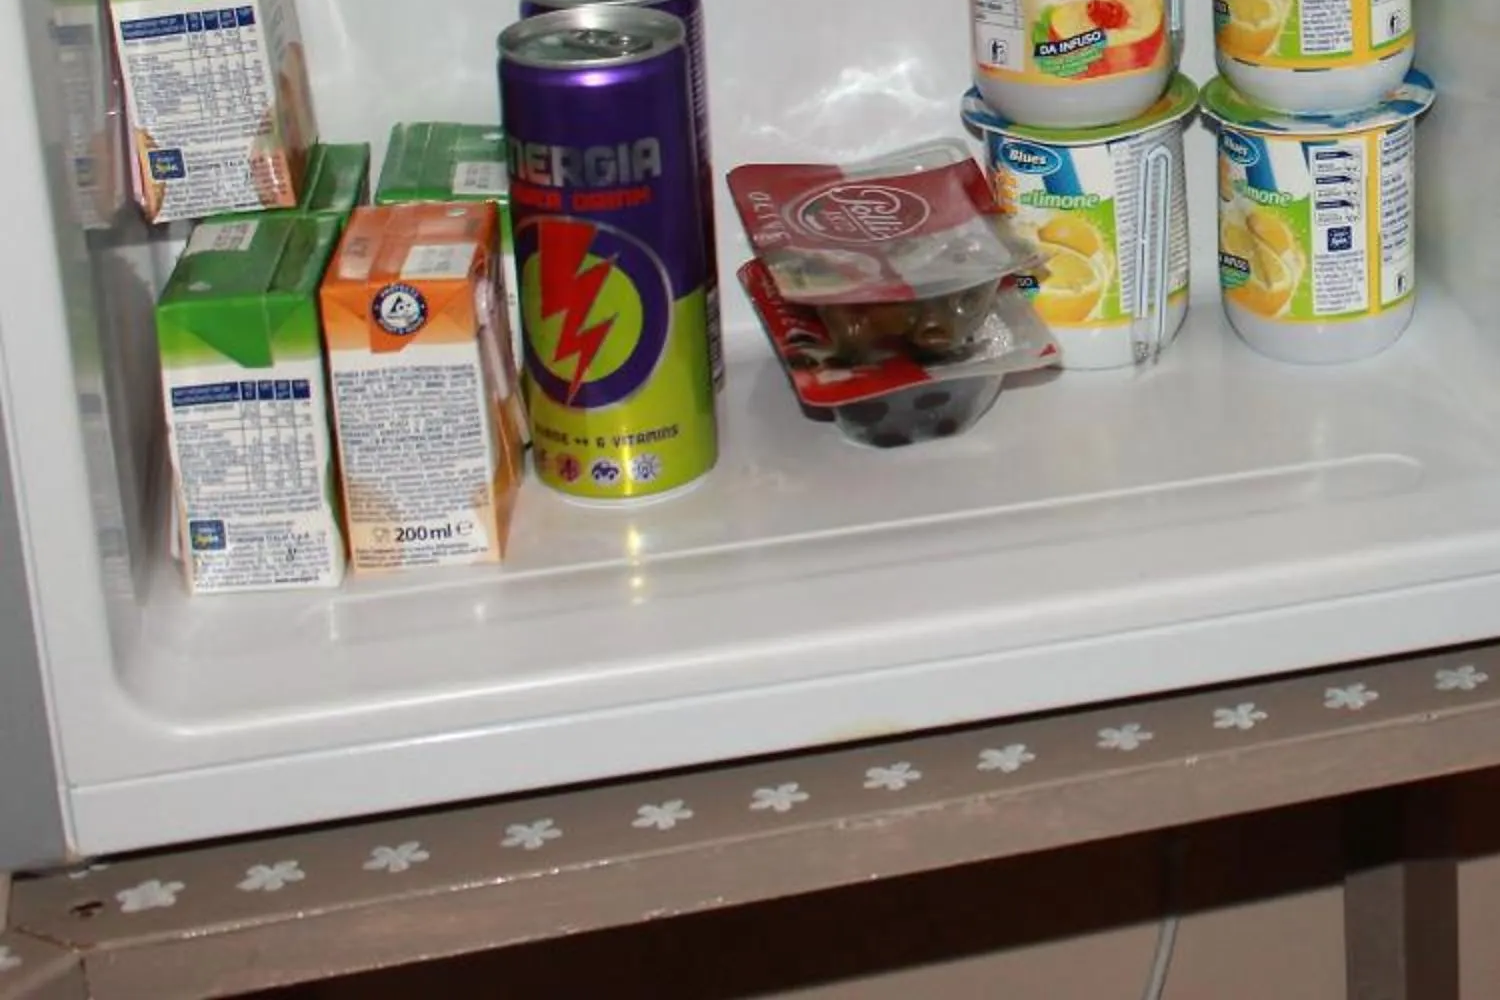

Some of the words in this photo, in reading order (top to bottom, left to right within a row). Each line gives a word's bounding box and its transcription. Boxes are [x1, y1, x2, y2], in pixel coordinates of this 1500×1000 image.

[1039, 44, 1058, 56] DA
[1059, 31, 1102, 53] INFUSO
[508, 136, 663, 189] NERGIA
[1009, 149, 1047, 166] Blues
[612, 423, 679, 449] VITAMINS
[394, 525, 428, 543] 200
[430, 523, 453, 541] ml
